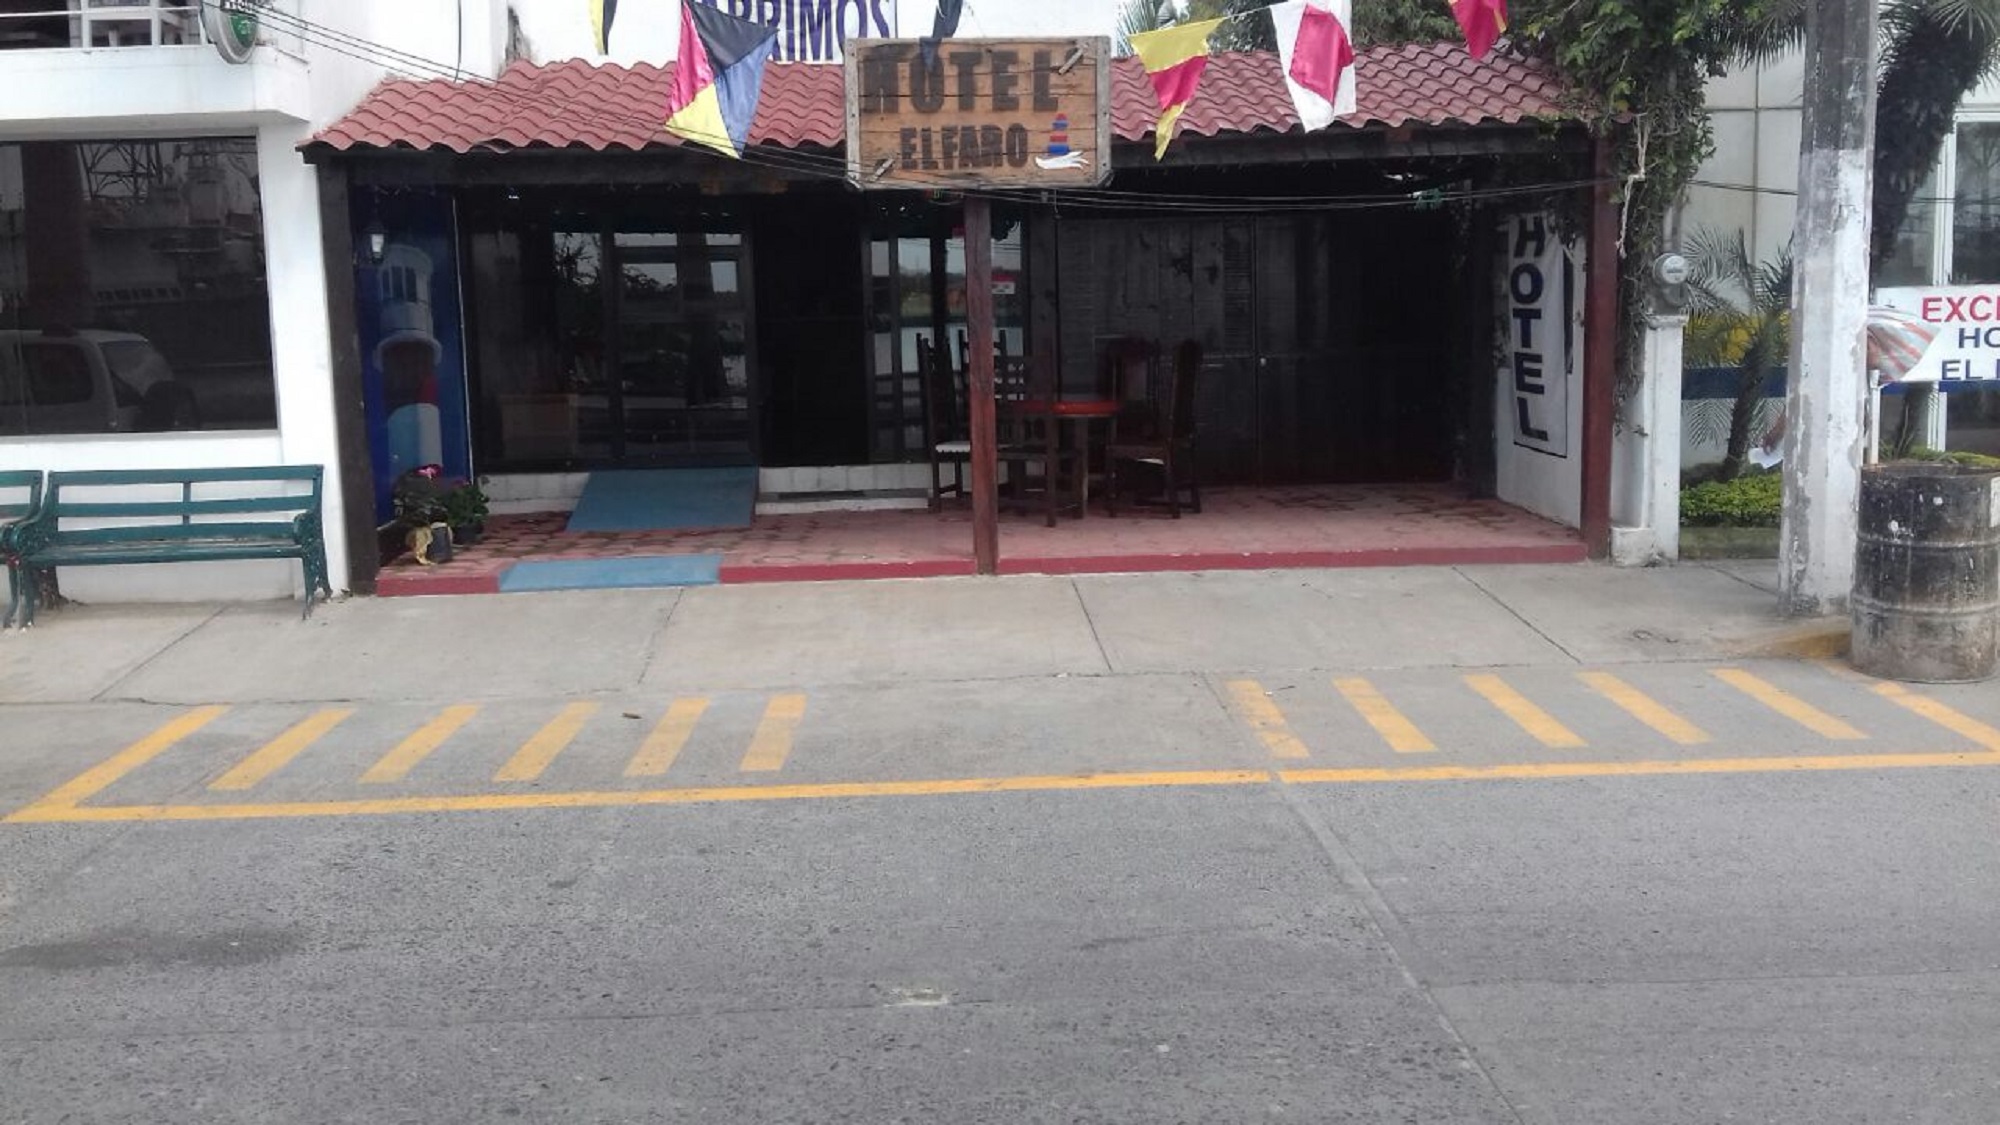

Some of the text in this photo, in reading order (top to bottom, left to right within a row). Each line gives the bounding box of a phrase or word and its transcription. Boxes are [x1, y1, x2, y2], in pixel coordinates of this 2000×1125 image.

[862, 48, 1059, 114] HOTEL
[1510, 215, 1549, 442] HOTEL
[1922, 295, 2000, 323] EXC
[1941, 359, 1984, 380] EL
